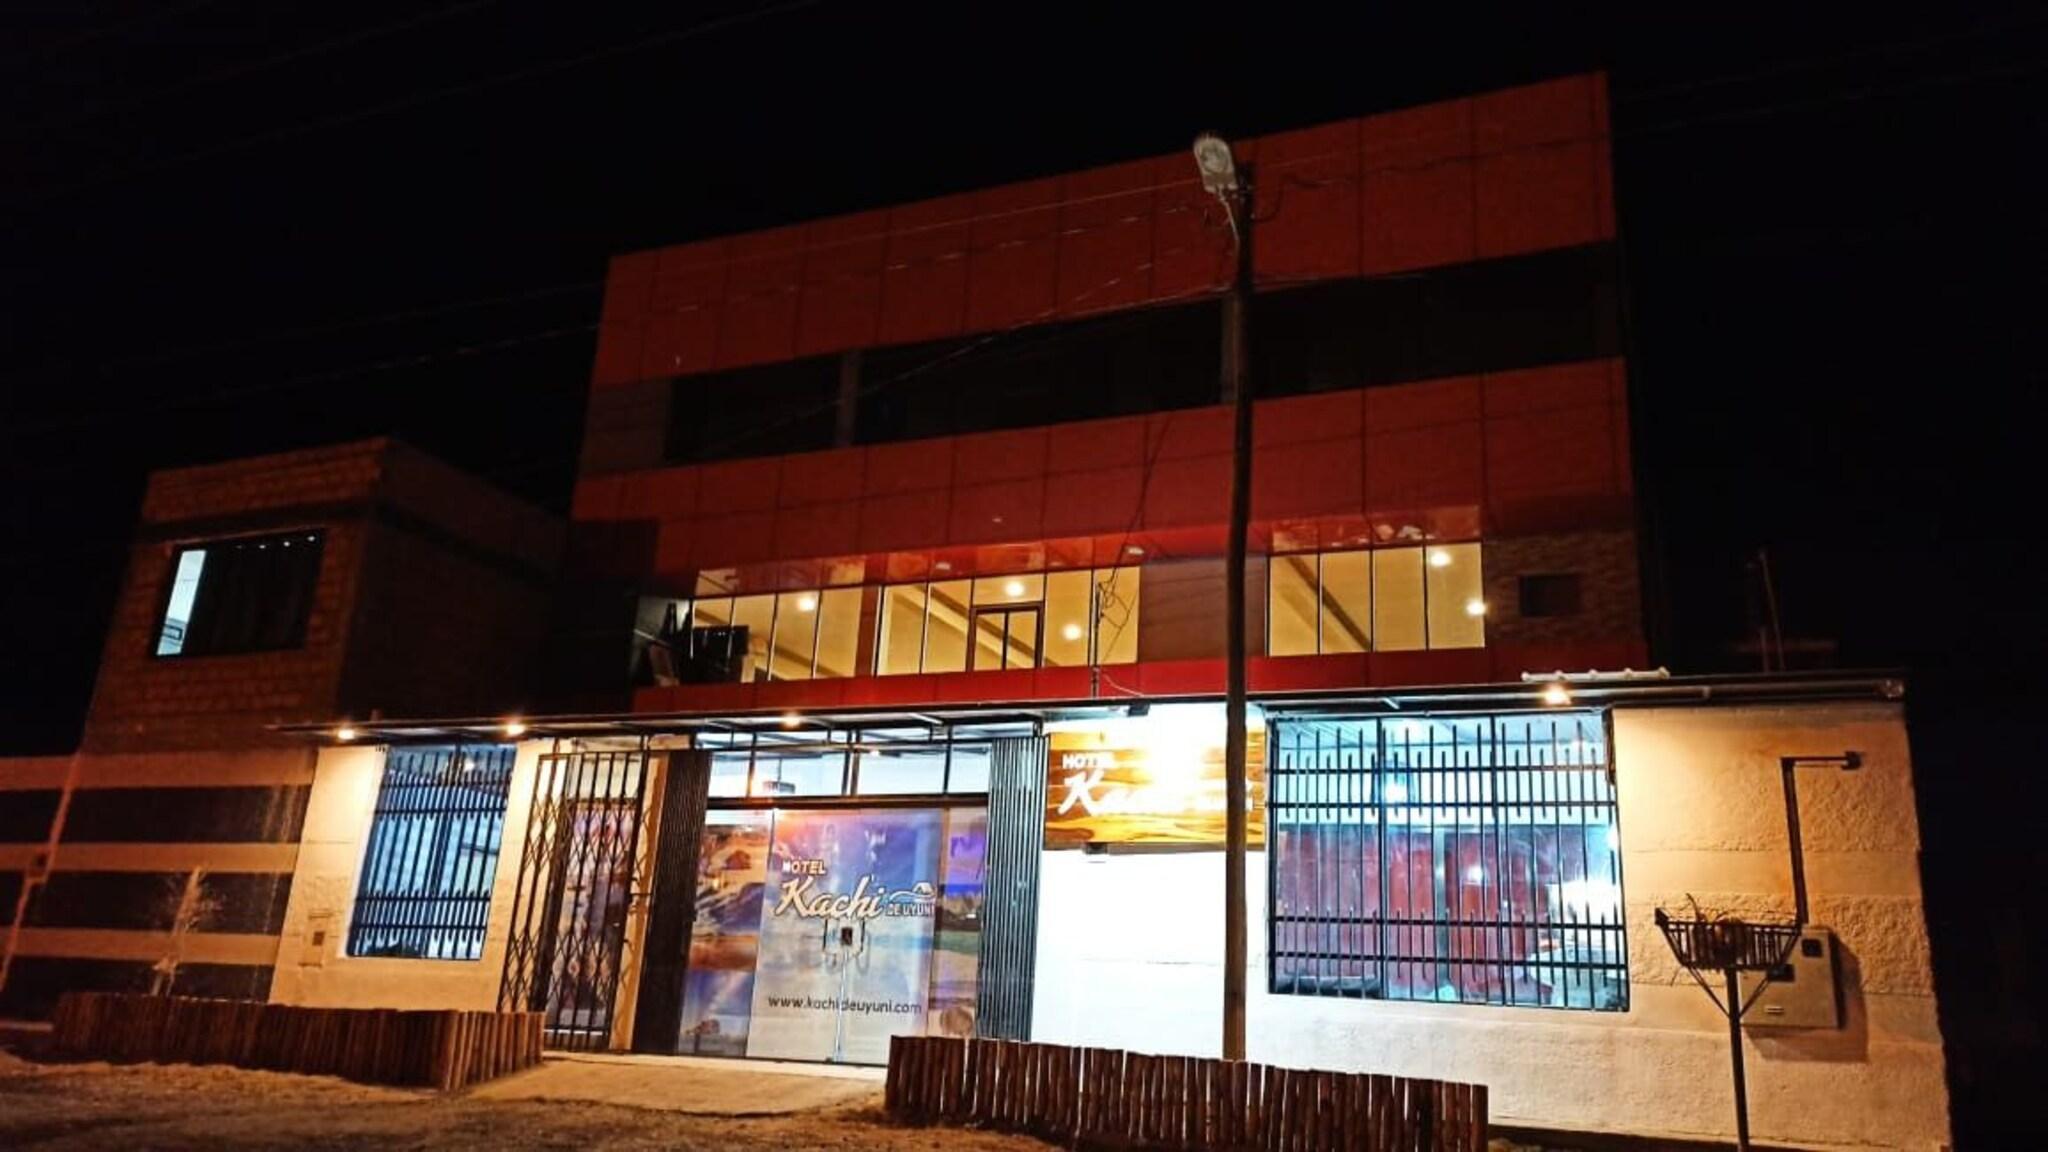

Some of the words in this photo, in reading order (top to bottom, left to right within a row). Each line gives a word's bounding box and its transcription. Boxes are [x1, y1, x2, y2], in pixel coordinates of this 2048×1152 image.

[1062, 752, 1115, 769] HOT
[782, 860, 826, 874] HOTEL
[775, 875, 884, 918] Kachi
[903, 903, 935, 917] UYUNI
[768, 996, 922, 1014] www.kachideuyuni.com
